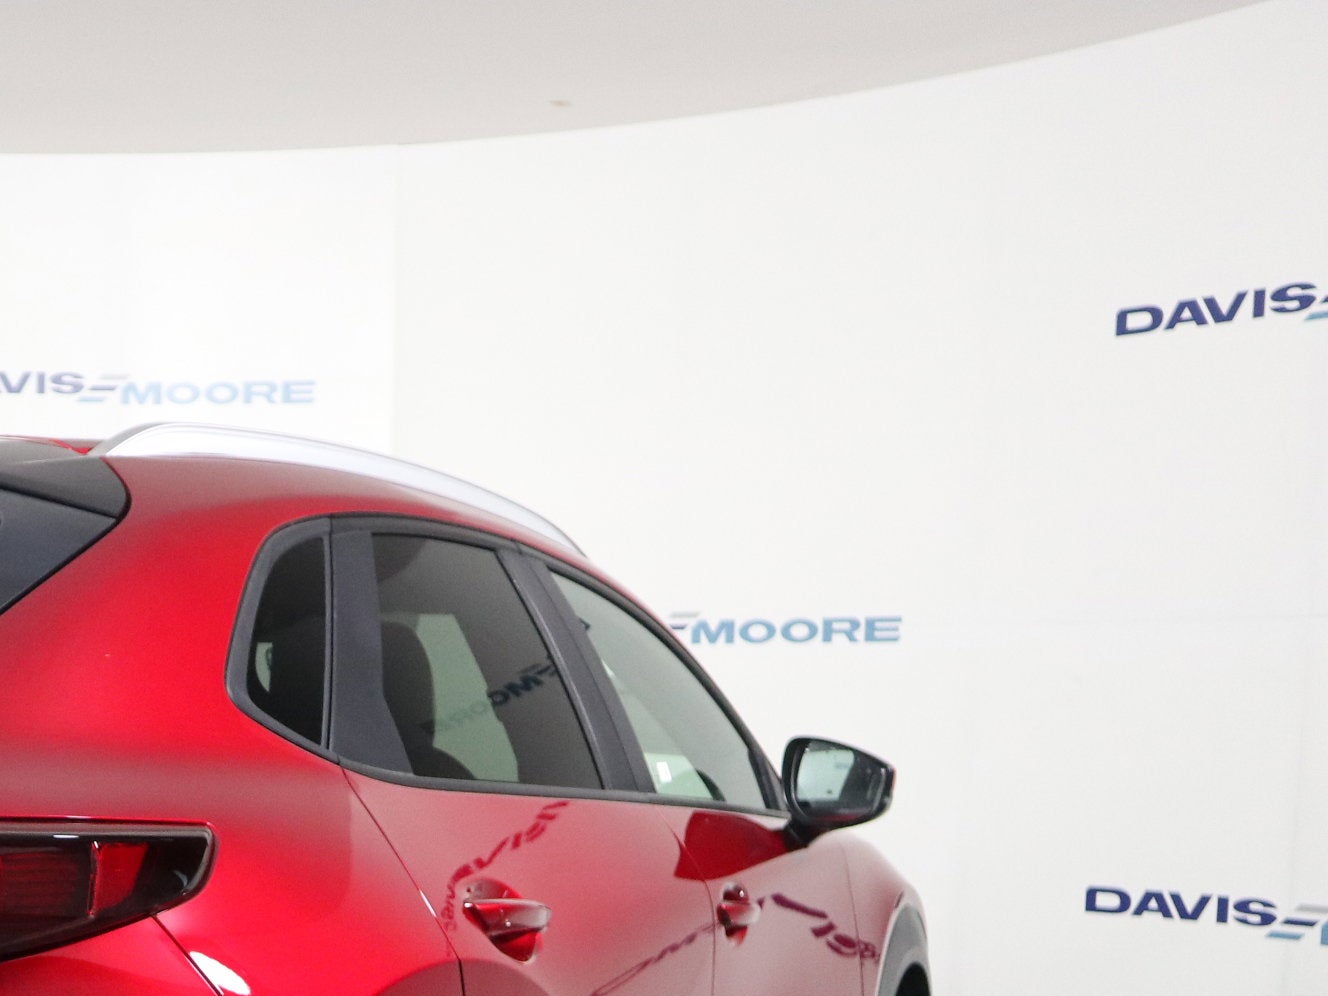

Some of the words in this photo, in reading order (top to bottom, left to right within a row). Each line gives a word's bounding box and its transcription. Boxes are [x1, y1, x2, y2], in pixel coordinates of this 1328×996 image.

[1115, 282, 1318, 336] DAVIS
[120, 378, 317, 406] MOORE
[690, 615, 903, 645] MOORE
[1084, 885, 1278, 927] DAVIS
